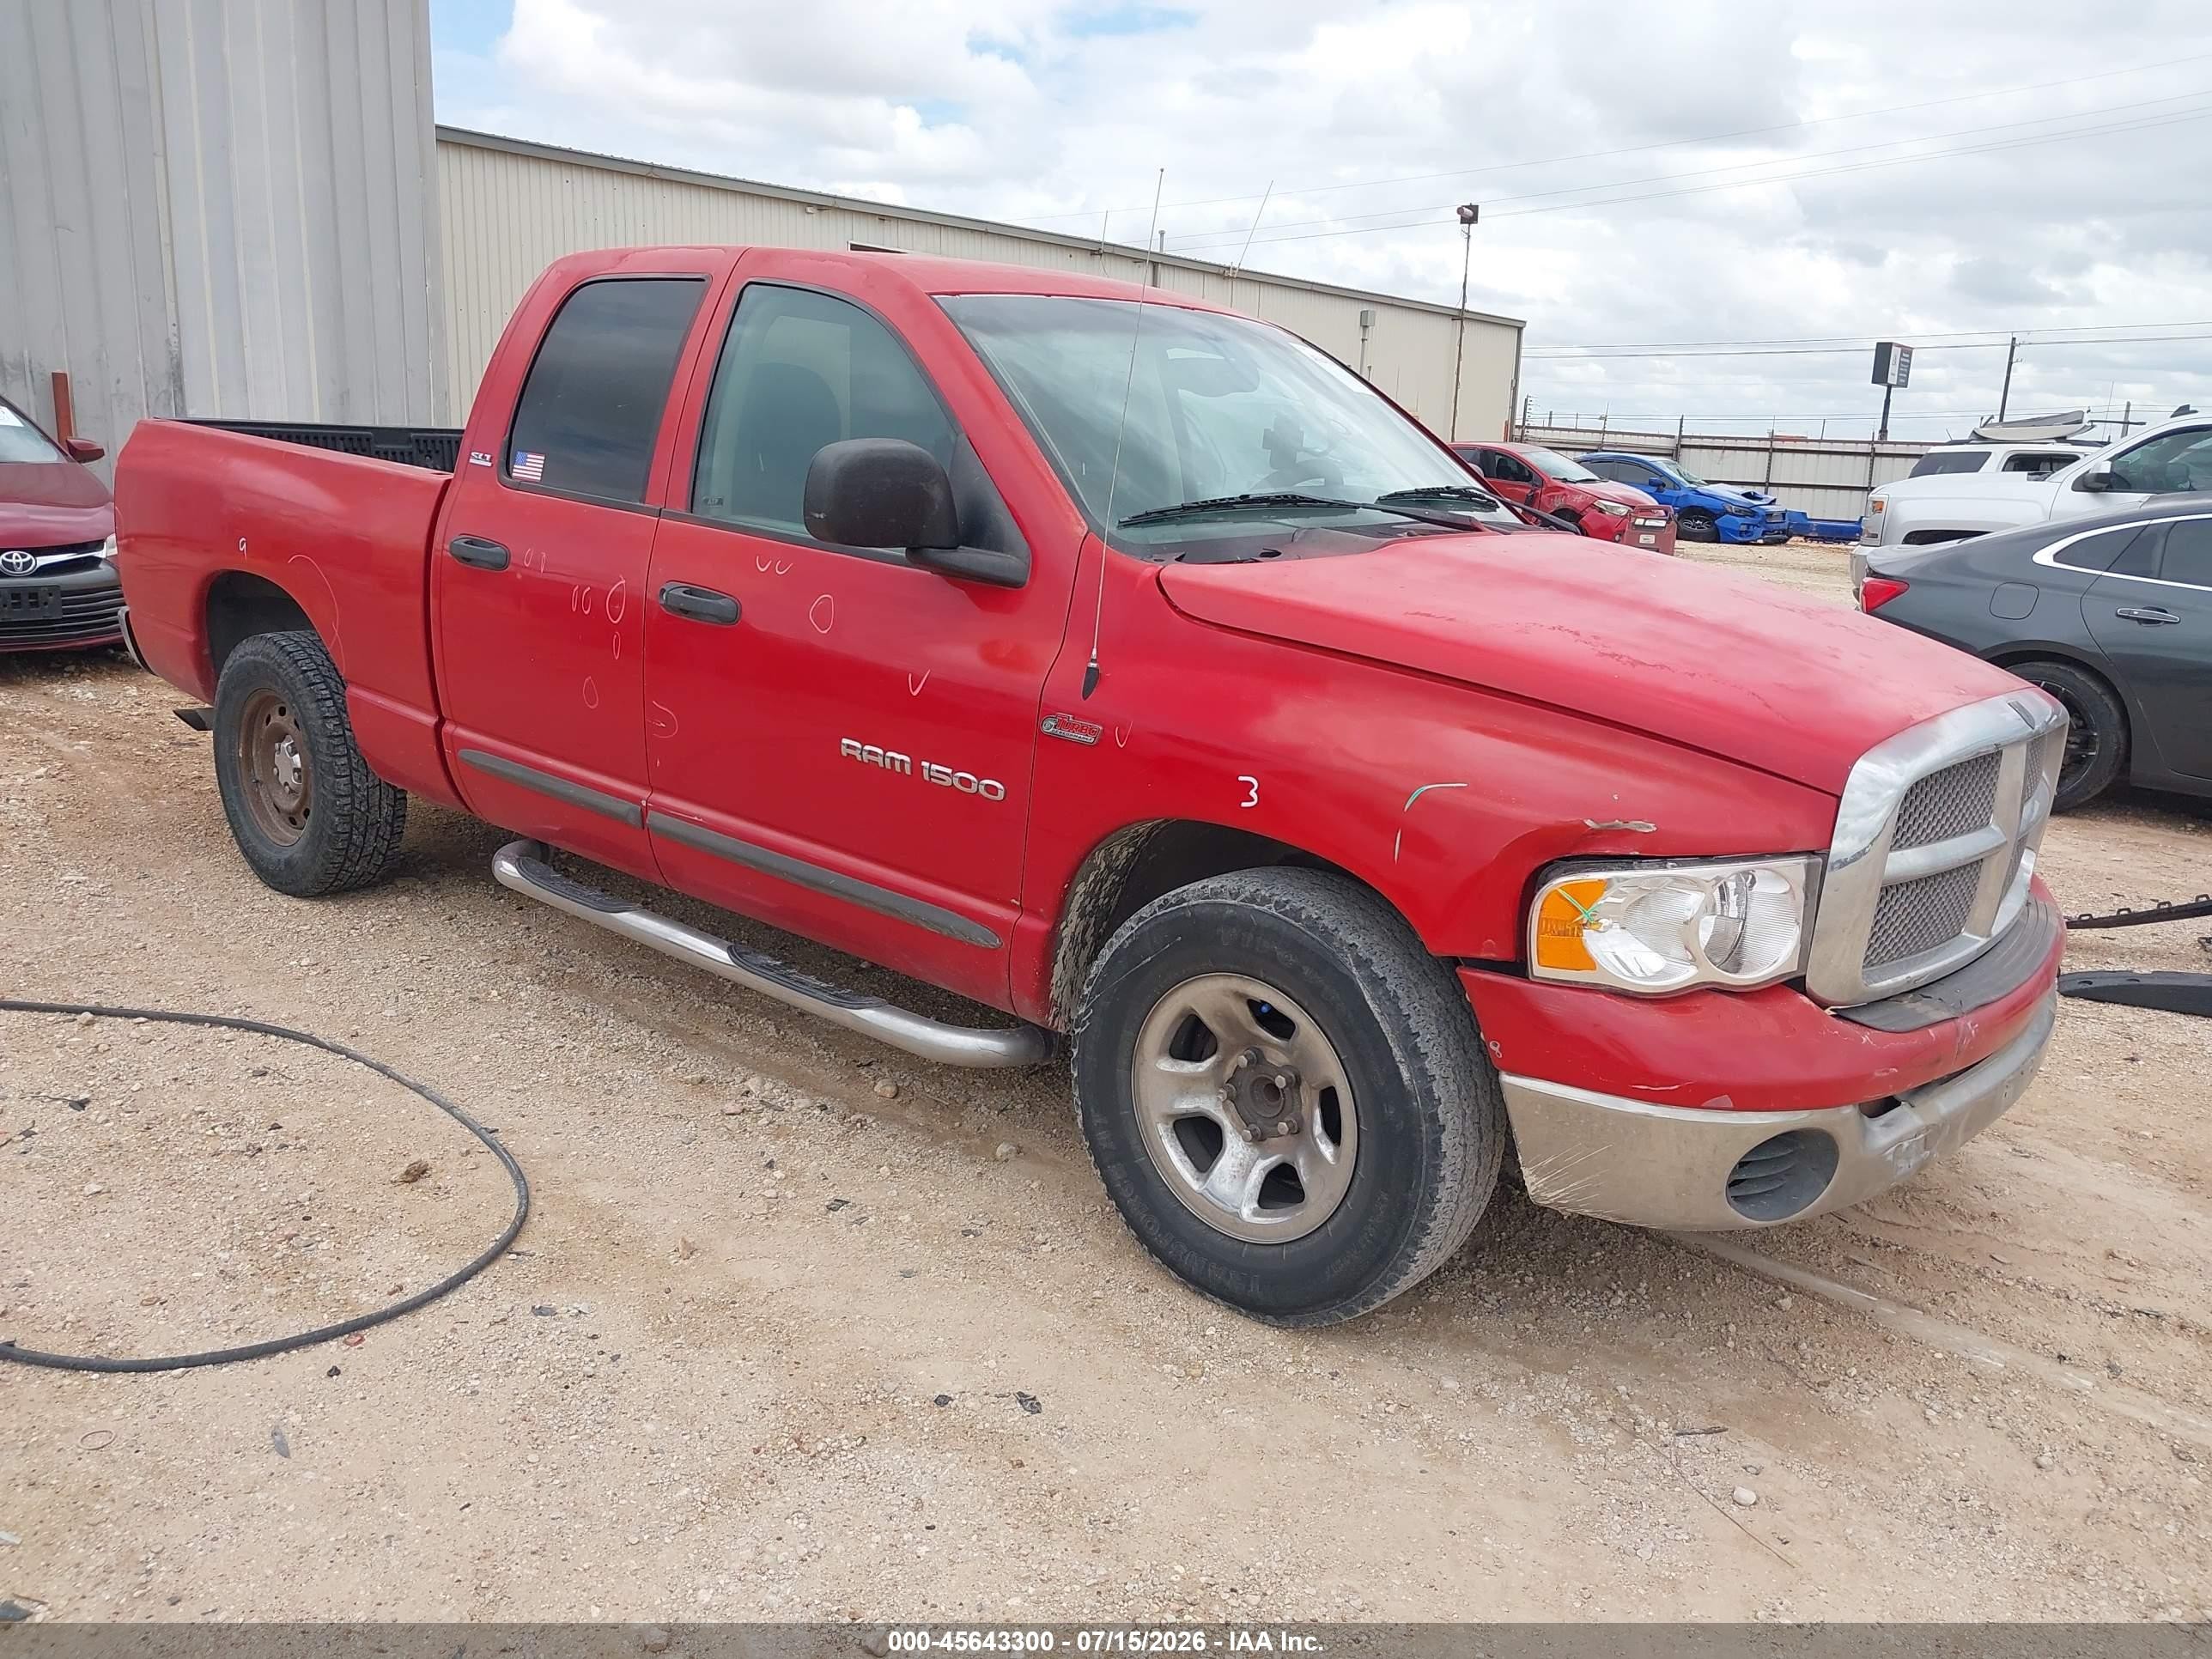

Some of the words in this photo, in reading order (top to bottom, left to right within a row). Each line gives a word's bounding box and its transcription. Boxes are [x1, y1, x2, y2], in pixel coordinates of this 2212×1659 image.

[841, 738, 912, 775] RAM
[921, 761, 1006, 802] 1500
[1237, 775, 1259, 808] 3
